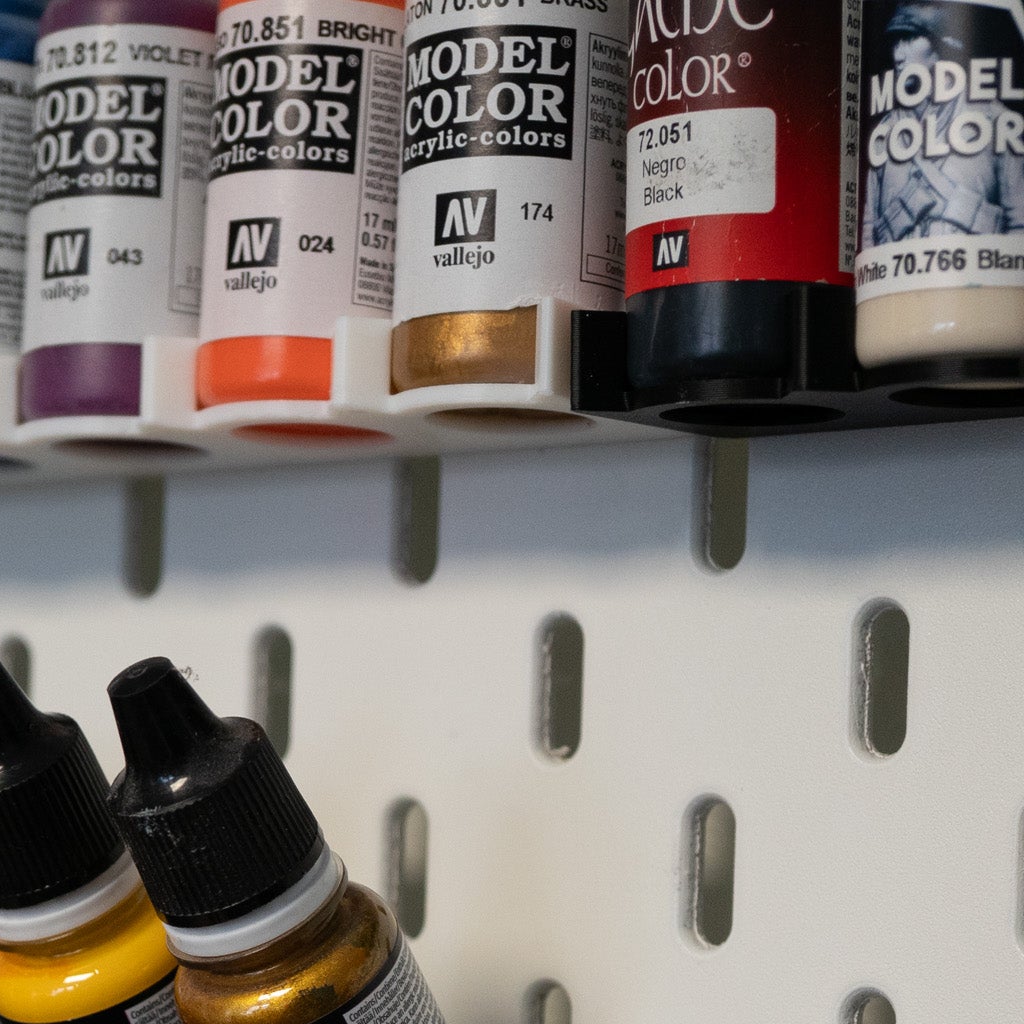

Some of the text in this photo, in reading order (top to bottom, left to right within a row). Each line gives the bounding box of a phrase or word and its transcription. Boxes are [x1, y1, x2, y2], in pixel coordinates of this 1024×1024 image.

[231, 15, 397, 48] 70.851 BRIGHT
[46, 40, 201, 71] 70.812 VIOLET
[407, 36, 571, 92] MODEL
[633, 48, 736, 111] COLOR
[870, 57, 1024, 116] MODEL
[209, 99, 352, 149] COLOR
[405, 82, 568, 136] COLOR
[404, 126, 567, 162] acrylic-colors
[638, 120, 693, 152] 72.051
[868, 111, 1024, 168] COLOR
[642, 155, 687, 179] Negro
[644, 185, 684, 207] Black
[364, 212, 379, 228] 17
[520, 202, 554, 222] 174
[298, 234, 336, 253] 024
[361, 231, 389, 250] 0.57
[107, 247, 144, 265] 043
[433, 245, 495, 269] vallejo
[893, 248, 966, 278] 70.766
[225, 270, 278, 294] vallejo
